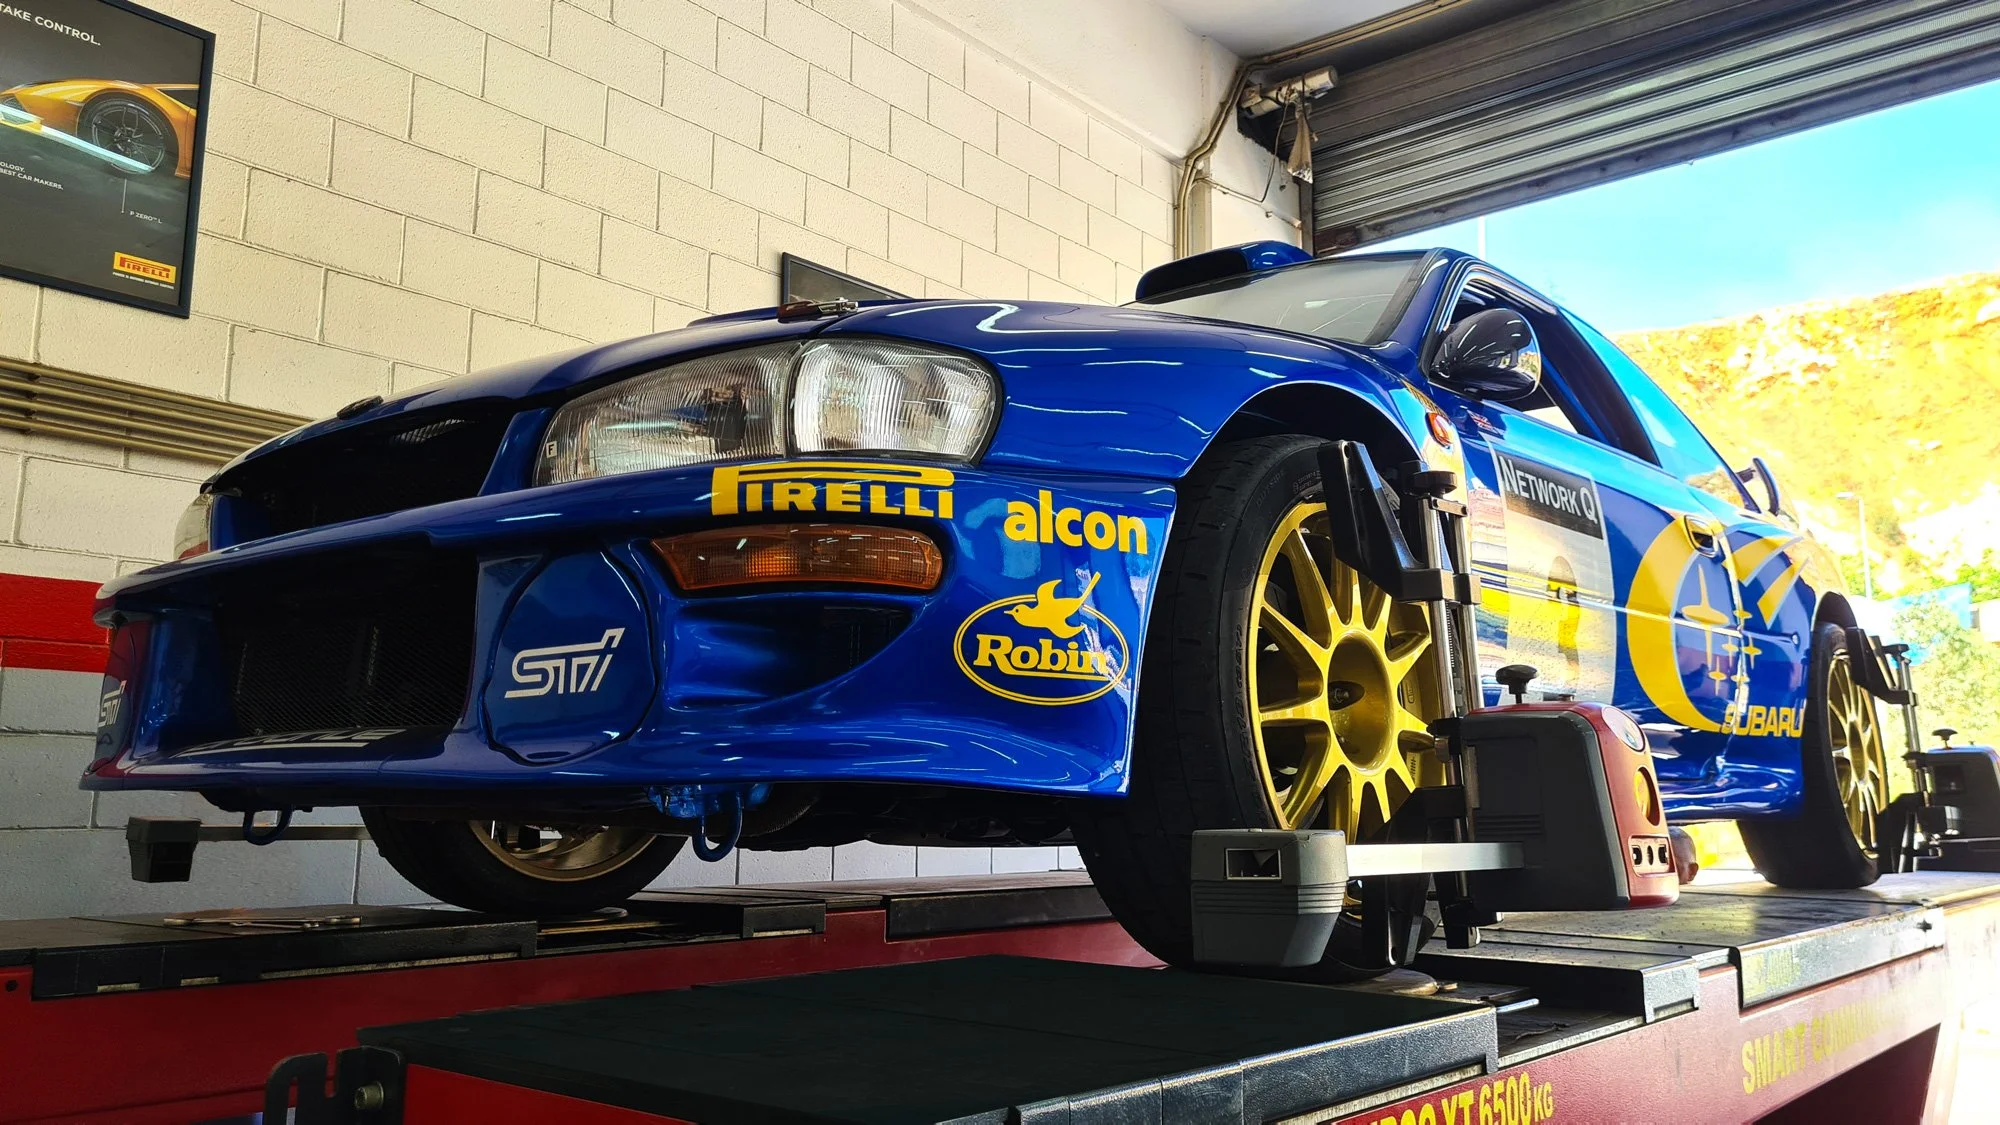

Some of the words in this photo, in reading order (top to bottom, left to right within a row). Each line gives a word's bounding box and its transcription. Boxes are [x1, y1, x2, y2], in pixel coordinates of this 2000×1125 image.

[0, 3, 32, 22] TAKE
[34, 16, 101, 46] CONTROL.
[0, 161, 26, 173] OLOGY.
[17, 172, 33, 182] CAR
[119, 256, 171, 279] PIRELLI
[711, 461, 955, 519] PIRELLI
[1498, 455, 1581, 517] NETWORK
[1579, 486, 1598, 525] Q
[1003, 490, 1148, 555] alcon
[973, 633, 1112, 681] Robin
[1721, 703, 1804, 738] SUBARU
[1742, 1021, 1806, 1094] SMART
